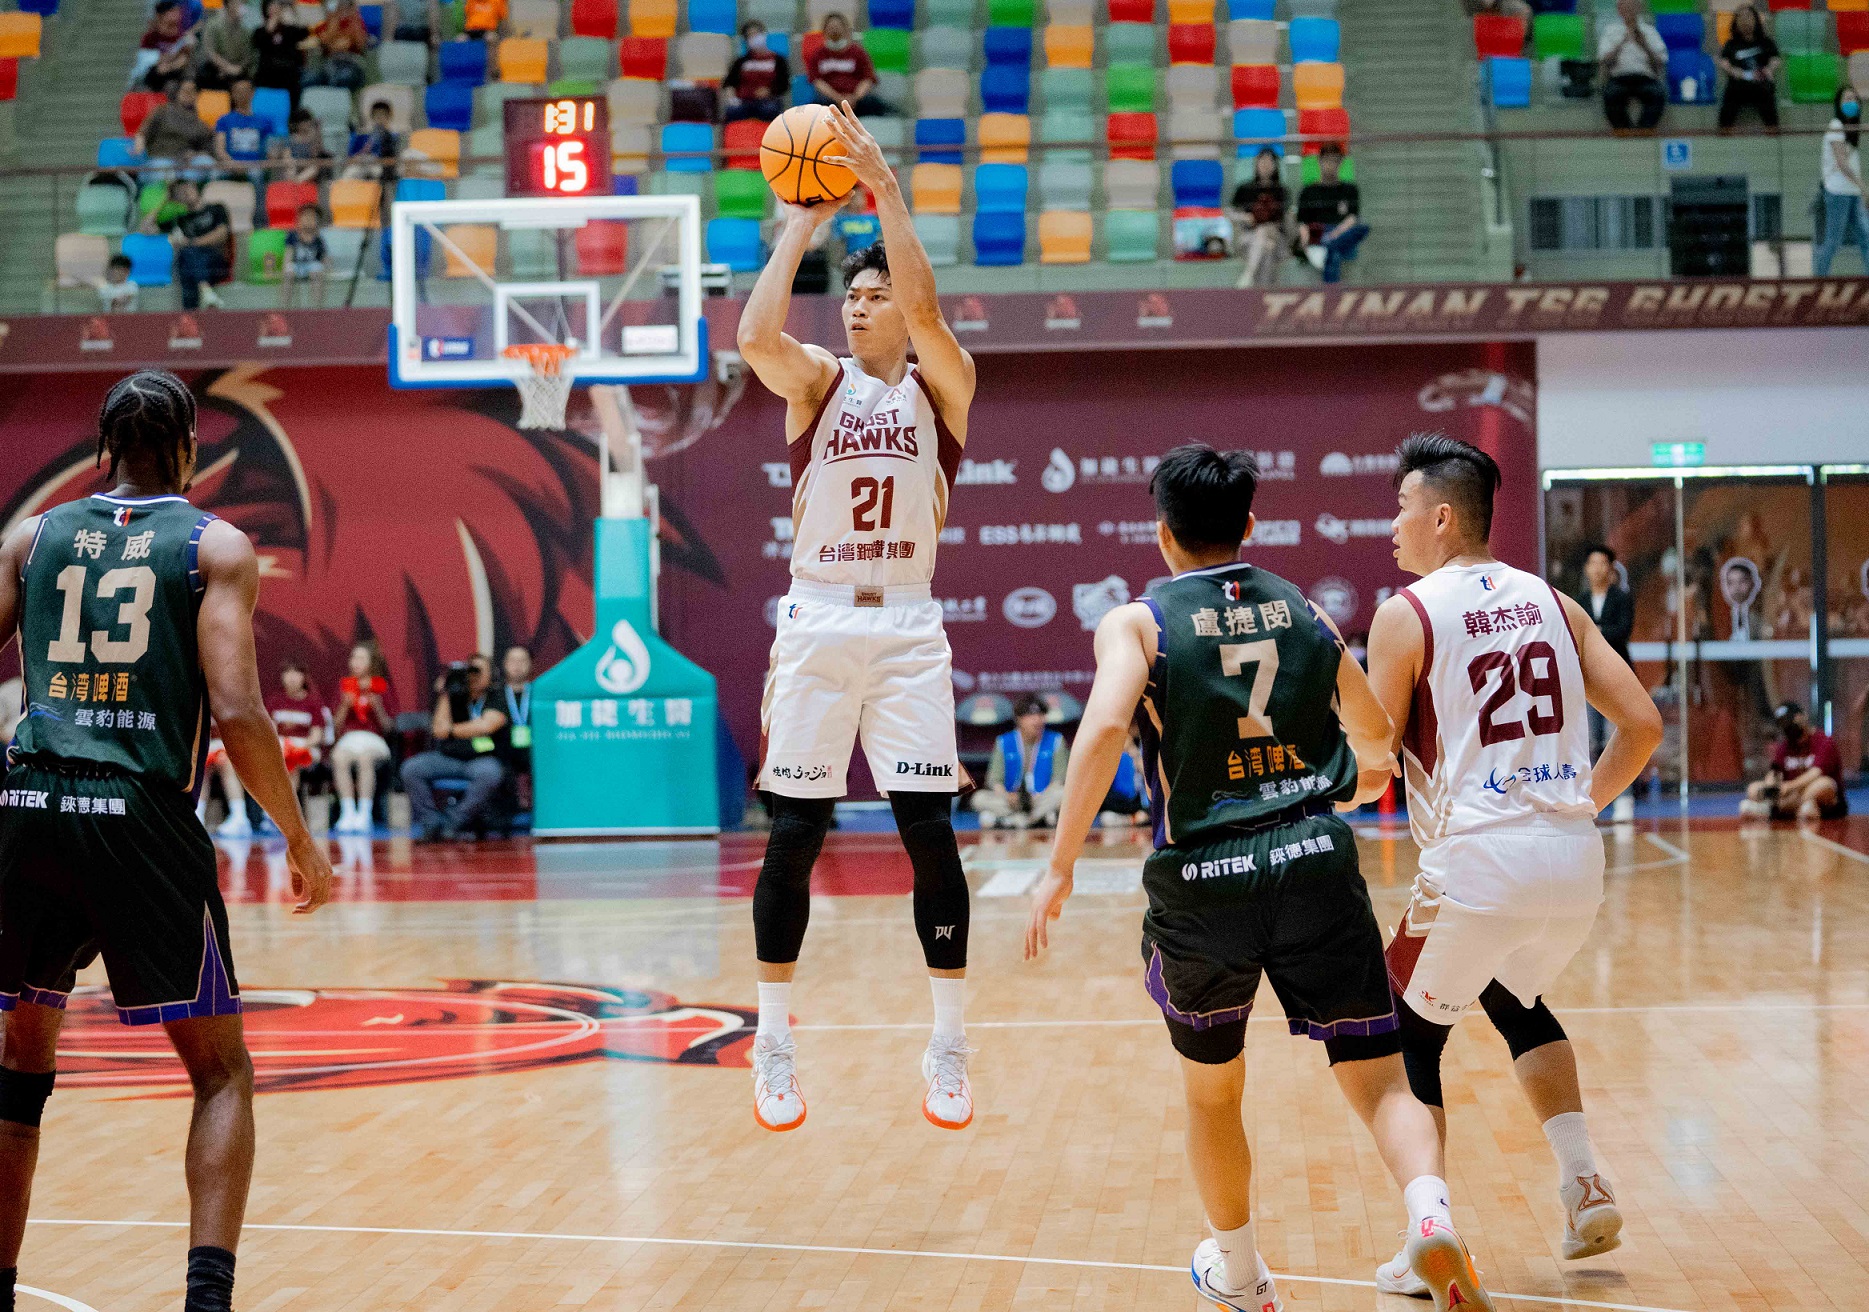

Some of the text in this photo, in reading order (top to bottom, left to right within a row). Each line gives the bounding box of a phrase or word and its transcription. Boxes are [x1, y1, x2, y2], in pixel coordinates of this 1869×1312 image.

[545, 101, 595, 134] 1:31
[544, 141, 588, 191] 15
[1254, 288, 1490, 332] TAINAN
[823, 426, 919, 460] HAWKS
[851, 475, 895, 532] 21
[73, 529, 156, 560] 特威
[47, 565, 157, 663] 13
[1190, 600, 1292, 637] 盧捷閔
[1462, 601, 1543, 638] 韓杰諭
[1219, 638, 1280, 739] 7
[1467, 641, 1564, 748] 29
[74, 708, 157, 730] 雲豹能源
[896, 761, 953, 778] D-Link
[1518, 762, 1577, 784] 全球人壽
[1269, 835, 1335, 866] 錸德集團
[1256, 1281, 1268, 1295] GT
